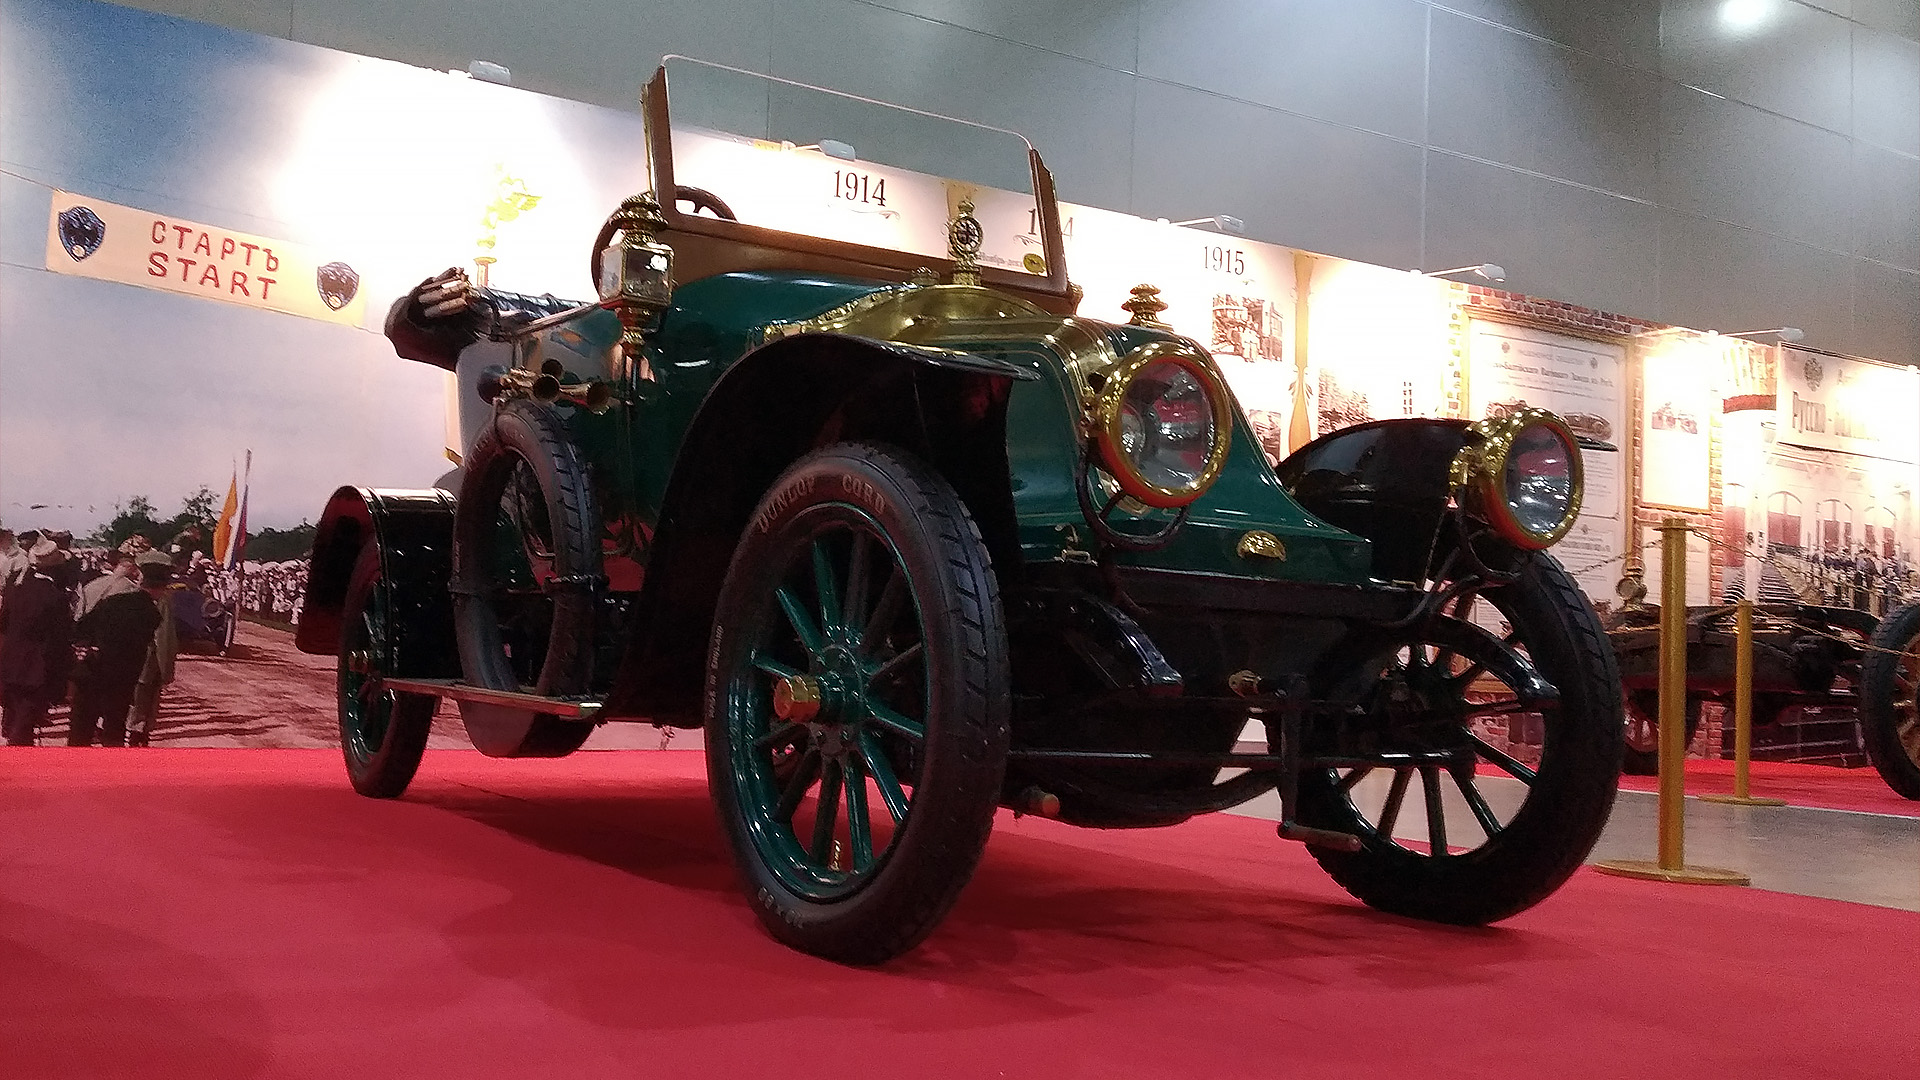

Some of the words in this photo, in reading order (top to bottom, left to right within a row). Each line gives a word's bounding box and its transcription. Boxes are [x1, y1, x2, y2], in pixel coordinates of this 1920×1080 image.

[834, 170, 887, 207] 1914
[152, 220, 279, 272] СТАРТЪ
[1028, 208, 1074, 241] 14
[148, 251, 277, 300] START
[1204, 246, 1245, 276] 1915
[757, 476, 815, 534] DUNLOP
[842, 474, 887, 515] CORD
